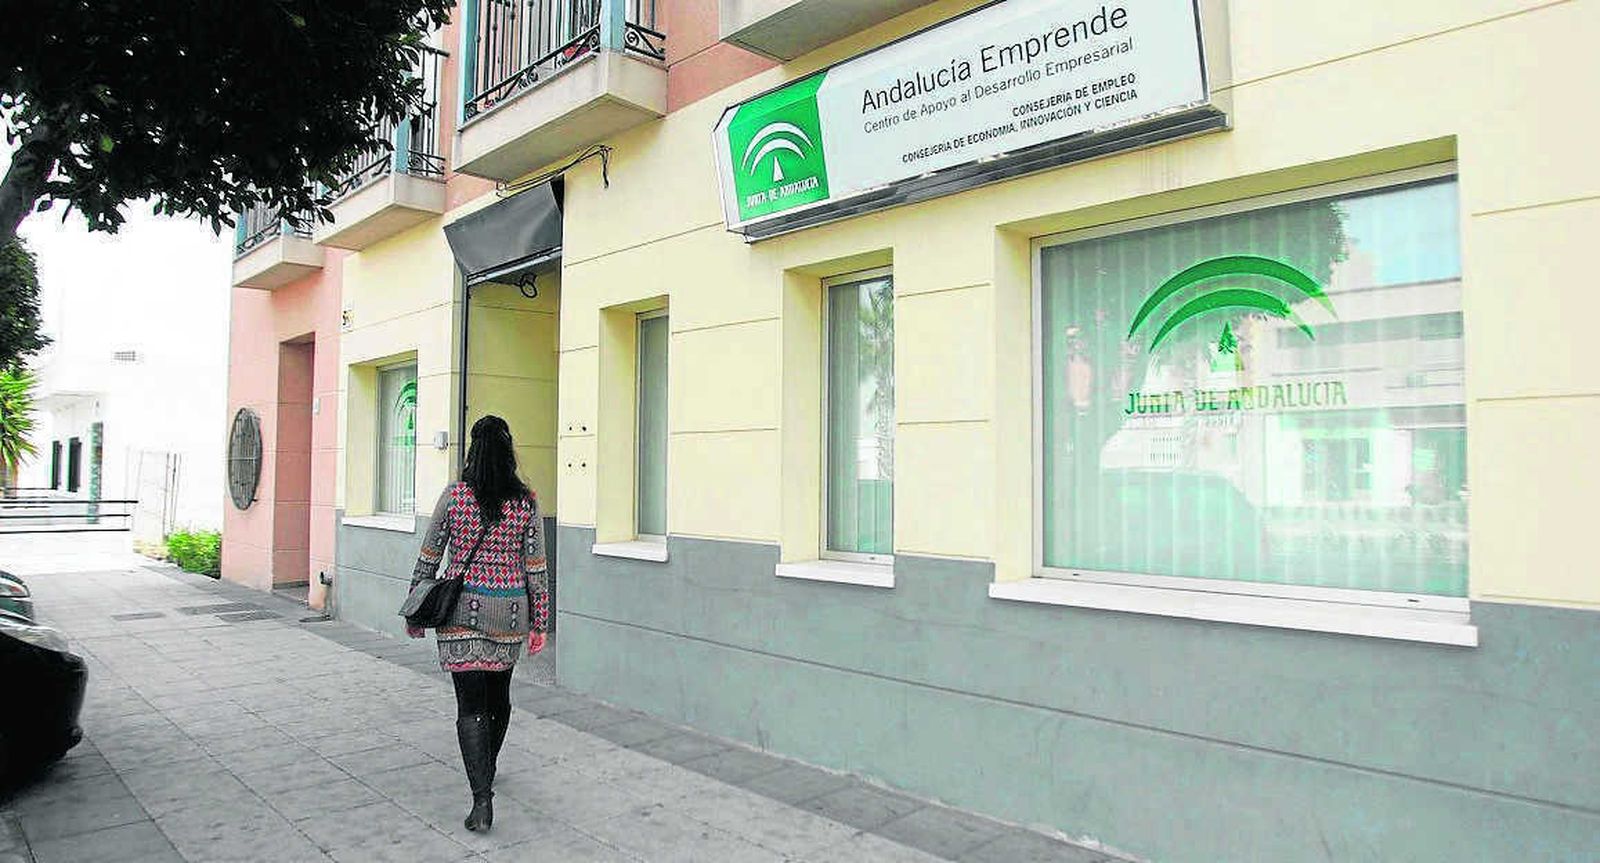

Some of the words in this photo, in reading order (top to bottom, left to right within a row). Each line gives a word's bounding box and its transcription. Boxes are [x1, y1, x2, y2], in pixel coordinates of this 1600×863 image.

[862, 59, 972, 114] Andalucía
[981, 5, 1128, 73] Emprende
[863, 116, 900, 134] Centro
[902, 108, 917, 121] de
[920, 96, 957, 118] Apoyo
[960, 90, 972, 104] al
[975, 67, 1041, 99] Desarrollo
[1046, 37, 1134, 78] Empresarial
[1075, 86, 1089, 99] DE
[1091, 72, 1137, 95] EMPLEO
[953, 137, 965, 148] DE
[1084, 101, 1092, 112] Y
[1094, 89, 1138, 109] CIENCIA
[1124, 390, 1185, 415] JUNTA
[1194, 388, 1218, 412] DE
